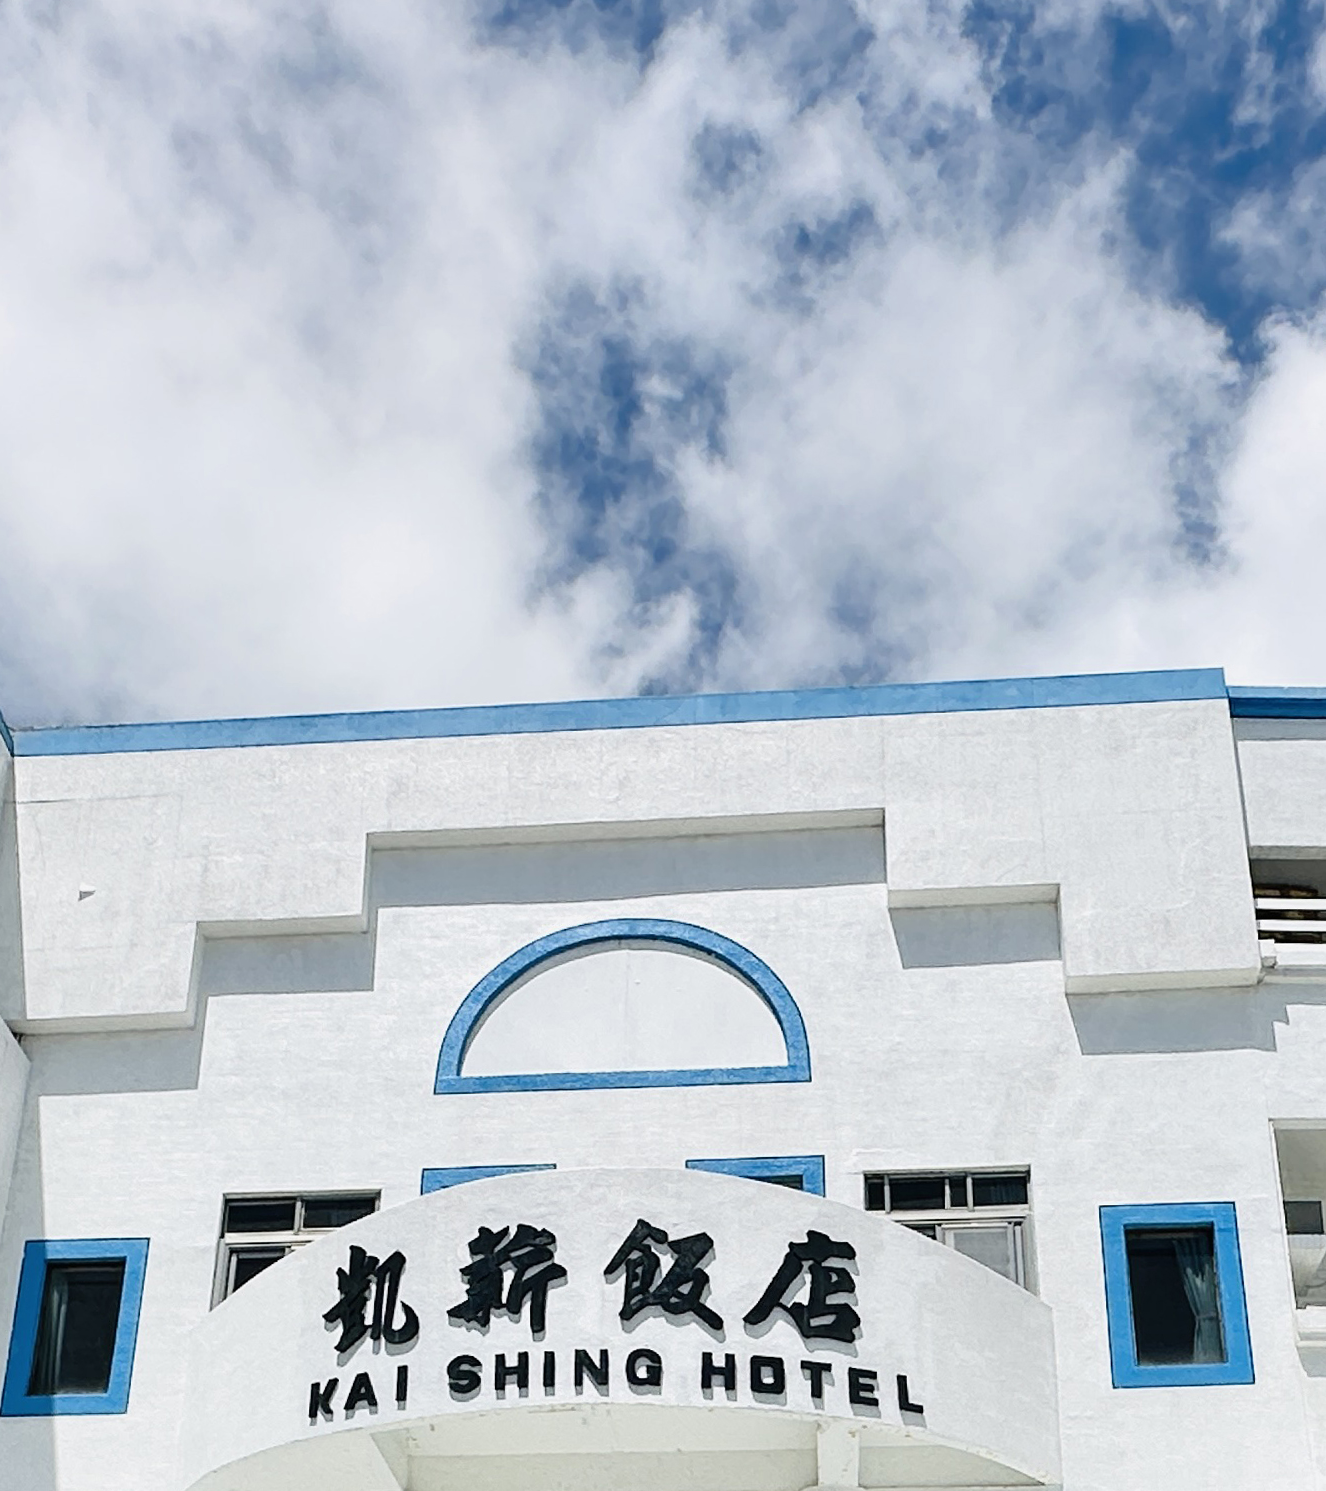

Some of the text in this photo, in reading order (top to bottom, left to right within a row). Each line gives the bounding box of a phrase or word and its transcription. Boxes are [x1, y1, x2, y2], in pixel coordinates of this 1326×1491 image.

[308, 1347, 925, 1421] KAI SHING HOTEL
